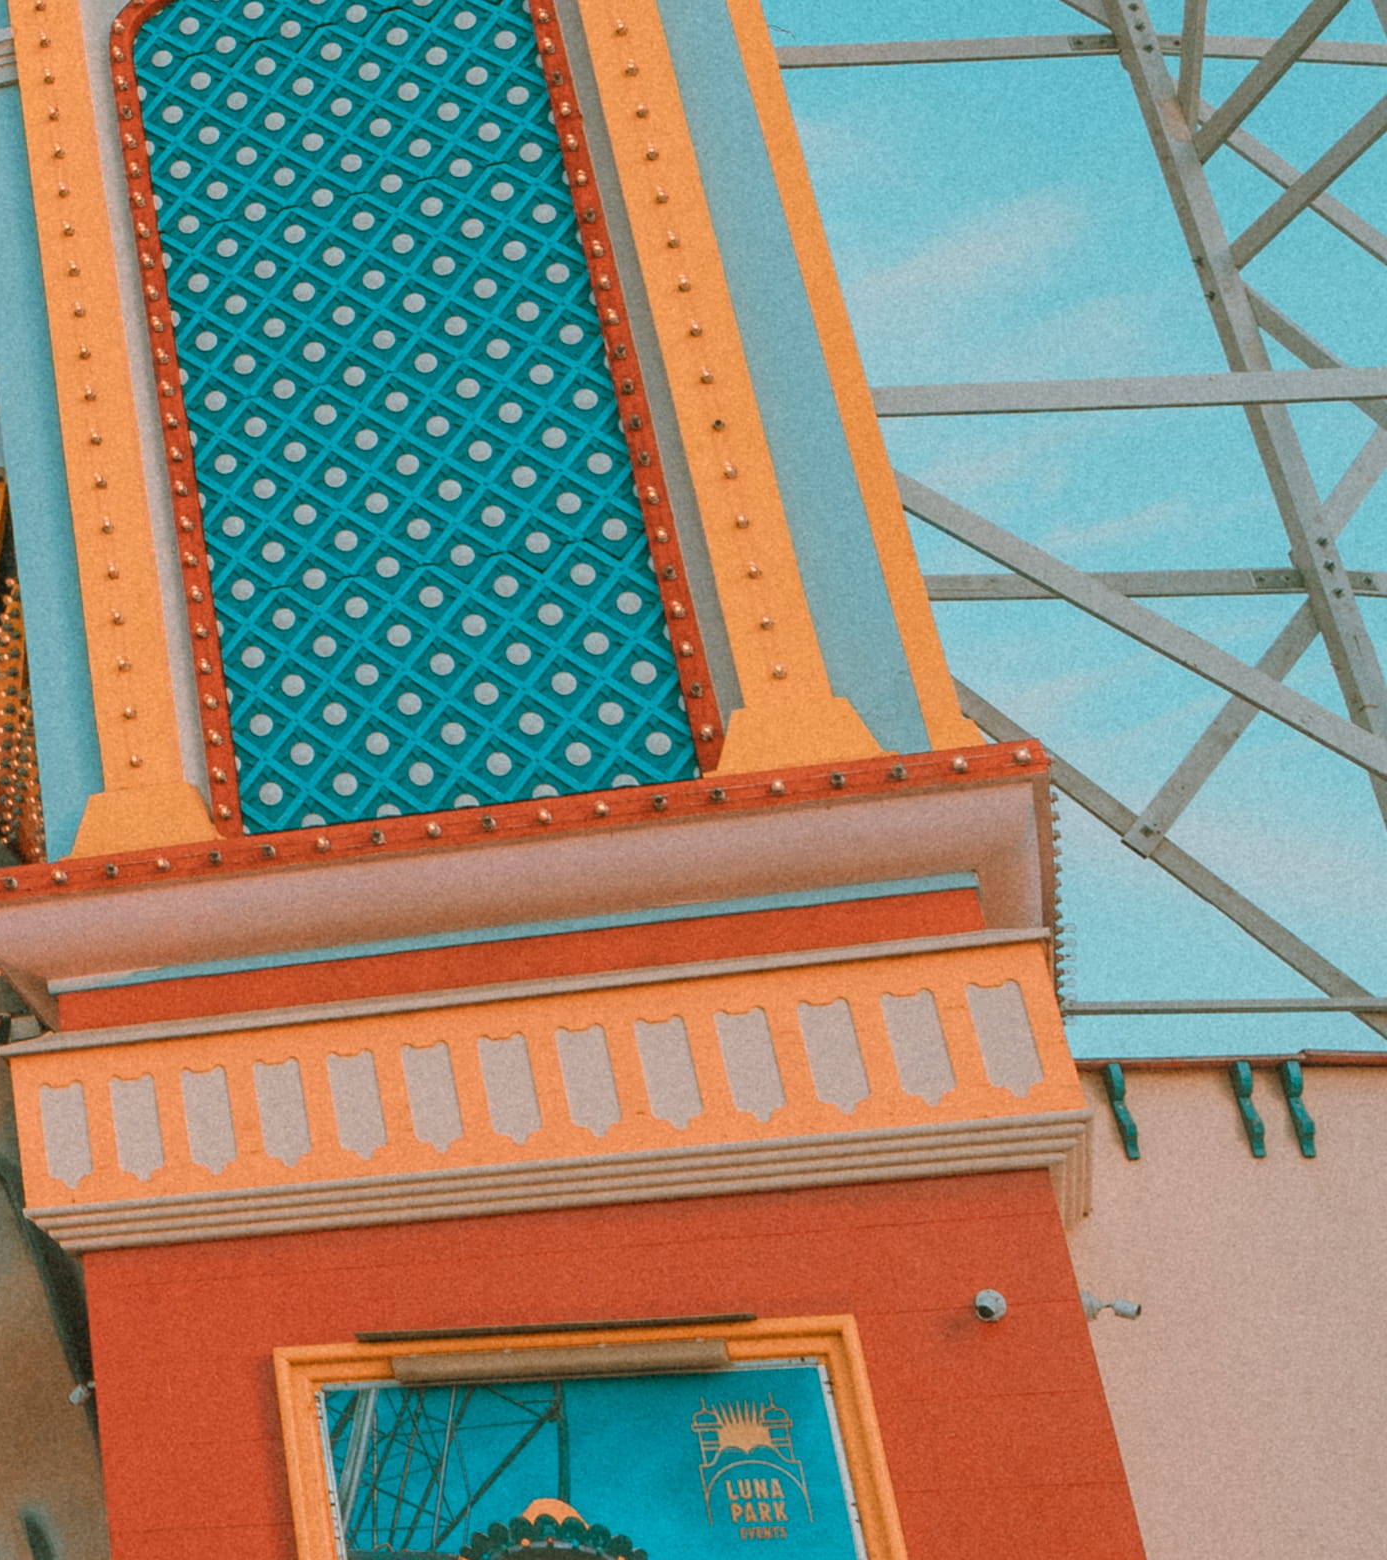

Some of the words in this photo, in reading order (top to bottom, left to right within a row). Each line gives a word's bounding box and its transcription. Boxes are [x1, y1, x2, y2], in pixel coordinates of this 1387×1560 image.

[725, 1478, 785, 1500] LUNA
[730, 1501, 789, 1522] PARK
[739, 1526, 788, 1540] EVENTS
